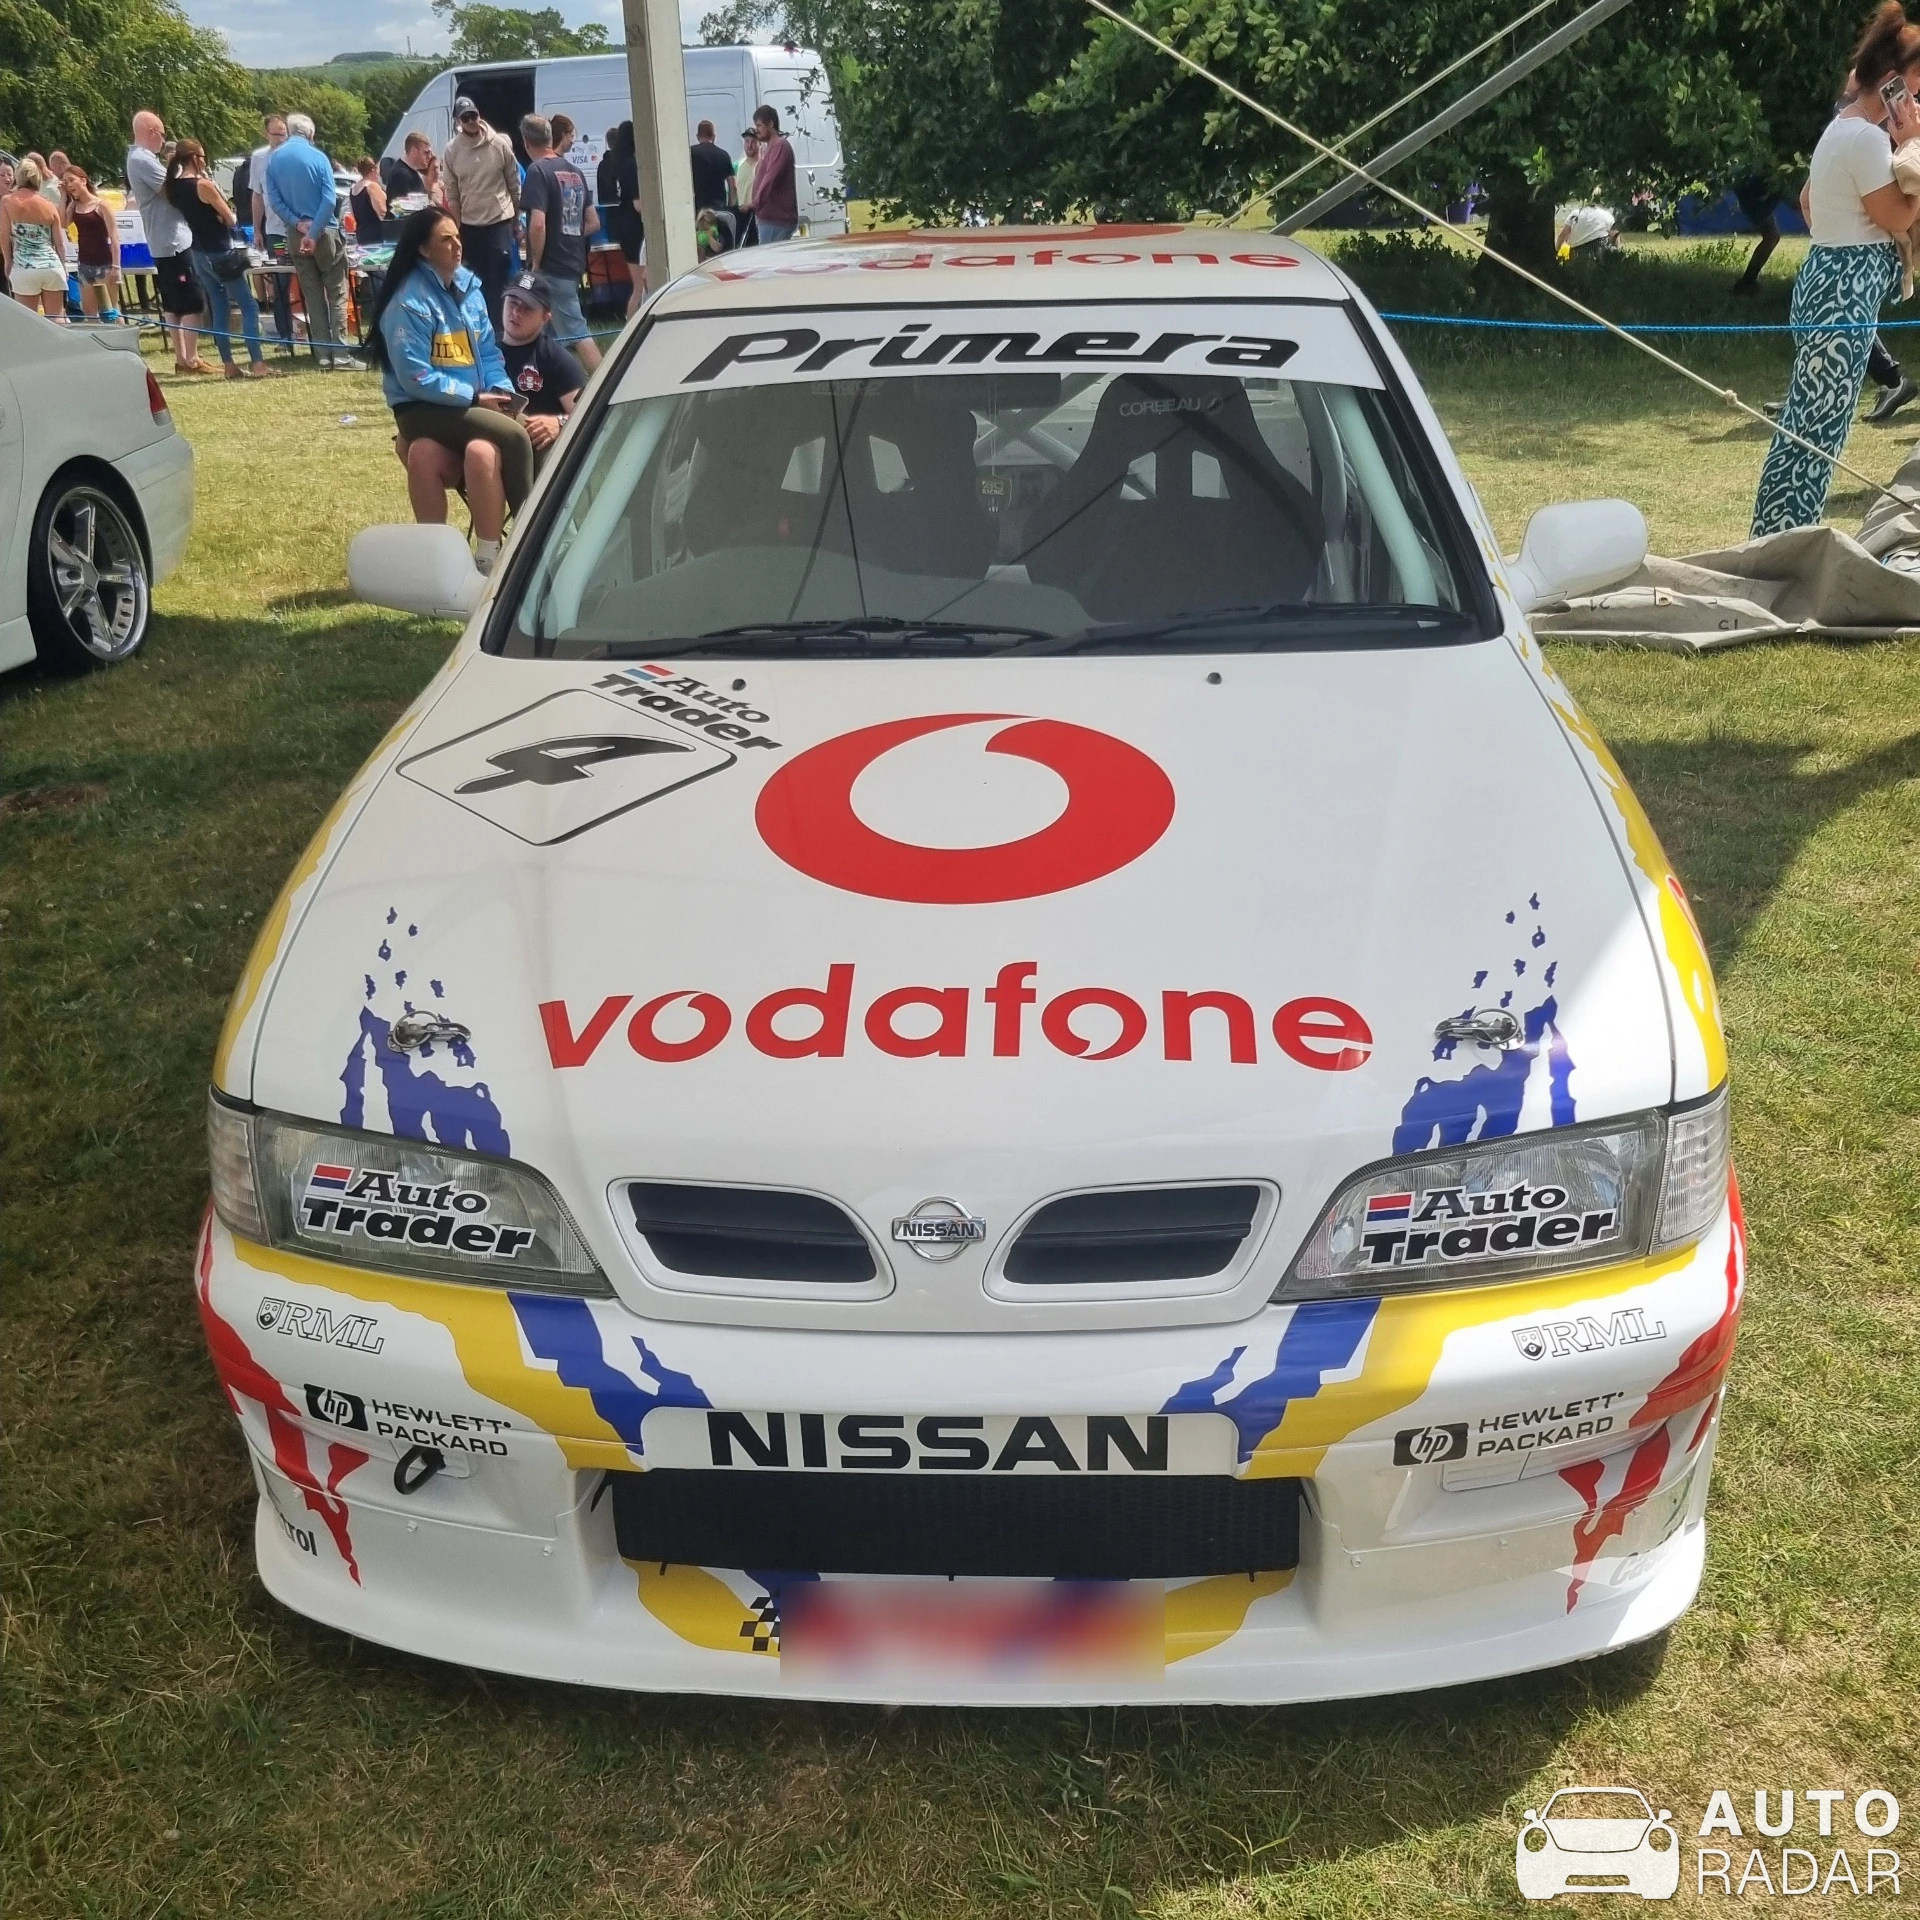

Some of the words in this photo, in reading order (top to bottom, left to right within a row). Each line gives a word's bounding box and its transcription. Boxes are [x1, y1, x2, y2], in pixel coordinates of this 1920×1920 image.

[571, 155, 589, 164] VISA
[709, 248, 1300, 283] vodafone
[679, 323, 1301, 384] Primera
[1119, 397, 1201, 416] CORBEAU
[590, 673, 784, 751] Trader
[652, 676, 771, 724] Auto
[453, 734, 697, 794] 4
[539, 961, 1374, 1071] vodafone
[344, 1170, 488, 1214] Auto
[1411, 1184, 1567, 1223] Auto
[302, 1196, 535, 1256] Trader
[901, 1221, 976, 1238] NISSAN
[1362, 1211, 1614, 1263] Trader
[277, 1301, 385, 1354] RML
[1542, 1307, 1666, 1357] RML
[371, 1398, 506, 1435] HEWLETT
[1478, 1393, 1618, 1433] HEWLETT
[376, 1420, 508, 1456] PACKARD
[706, 1411, 1169, 1472] NISSAN
[1476, 1416, 1614, 1457] PACKARD
